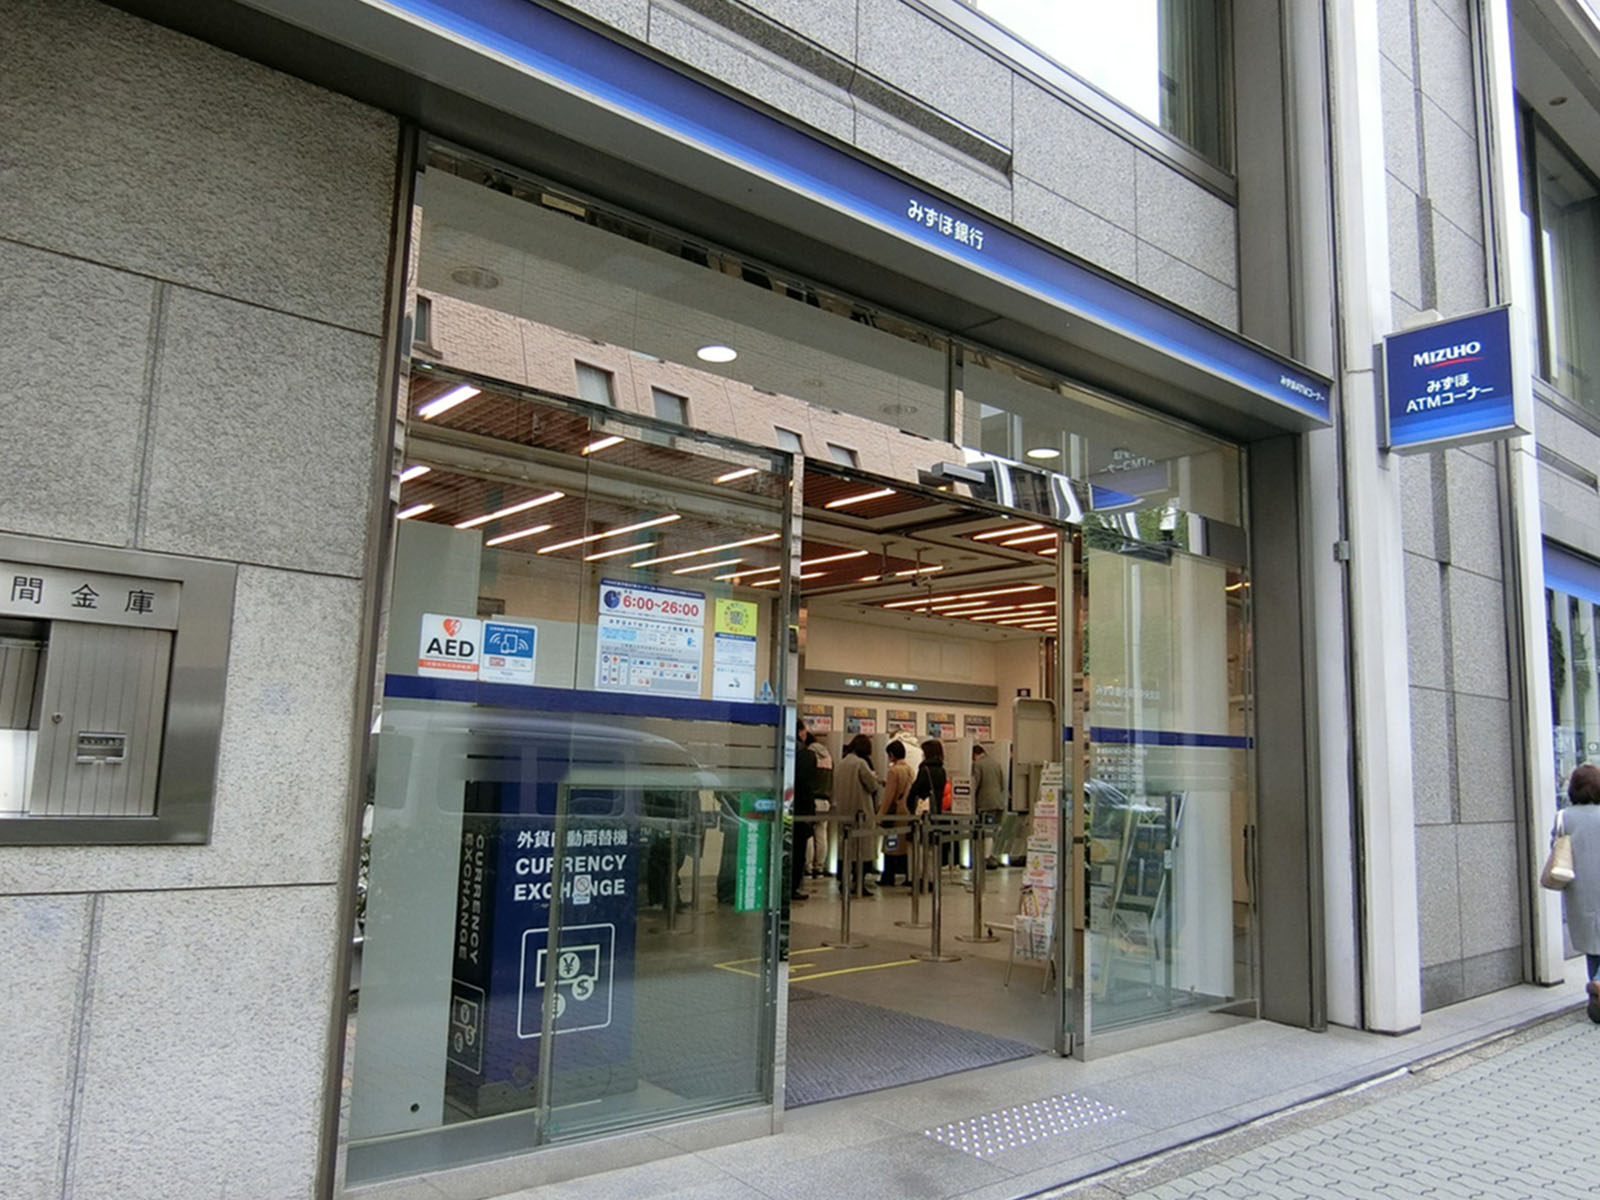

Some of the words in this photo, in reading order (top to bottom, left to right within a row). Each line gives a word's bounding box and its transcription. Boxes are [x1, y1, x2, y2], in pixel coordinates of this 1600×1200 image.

[907, 199, 984, 250] みずほ銀行
[1413, 341, 1481, 368] MIZUHO
[1426, 372, 1470, 394] みずほ
[1406, 386, 1494, 413] ATMコーナー
[10, 575, 155, 615] 間金庫
[426, 638, 475, 658] AED
[458, 833, 474, 960] EXCHANGE
[469, 834, 485, 964] CURRENCY
[513, 879, 626, 902] EXCHNGE
